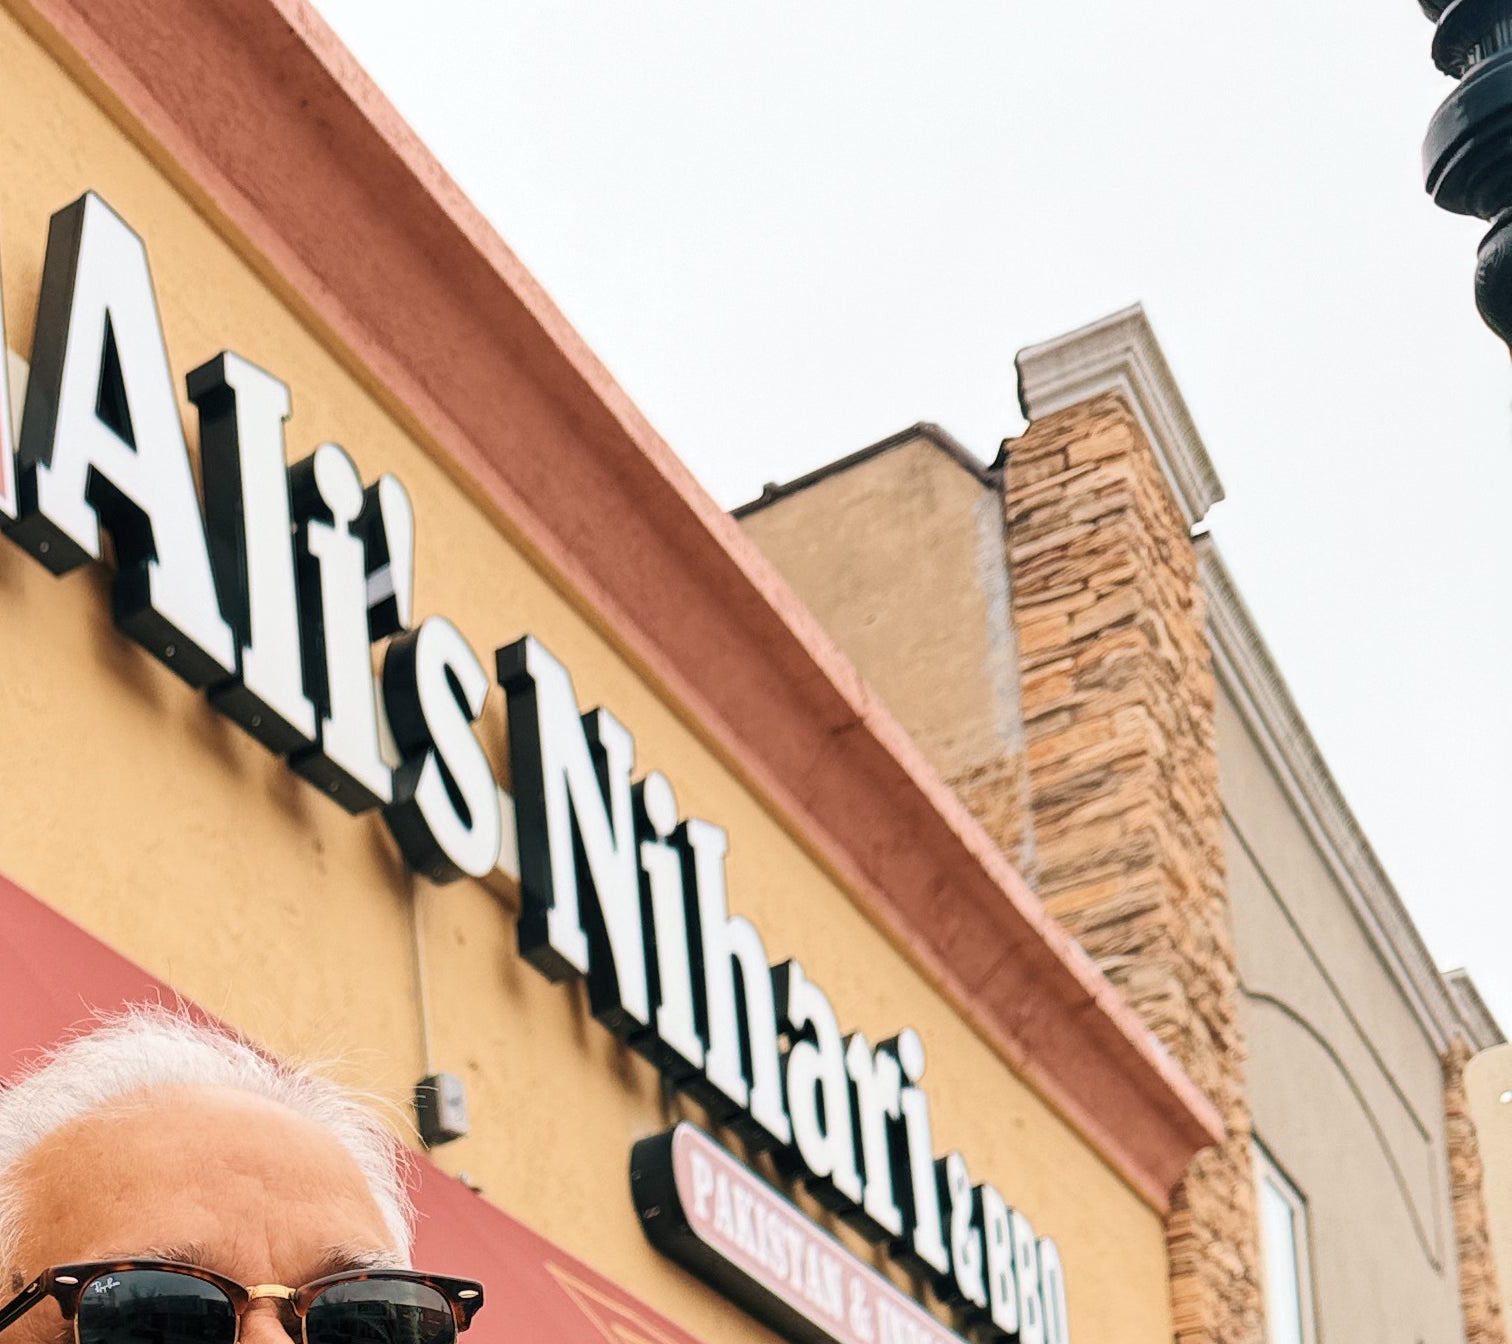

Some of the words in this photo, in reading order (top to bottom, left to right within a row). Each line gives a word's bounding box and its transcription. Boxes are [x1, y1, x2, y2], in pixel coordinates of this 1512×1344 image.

[36, 189, 500, 877] Ali's
[525, 634, 949, 1274] Nihari
[946, 1151, 986, 1308] &
[691, 1150, 844, 1321] PAKISTAN
[849, 1276, 875, 1343] &
